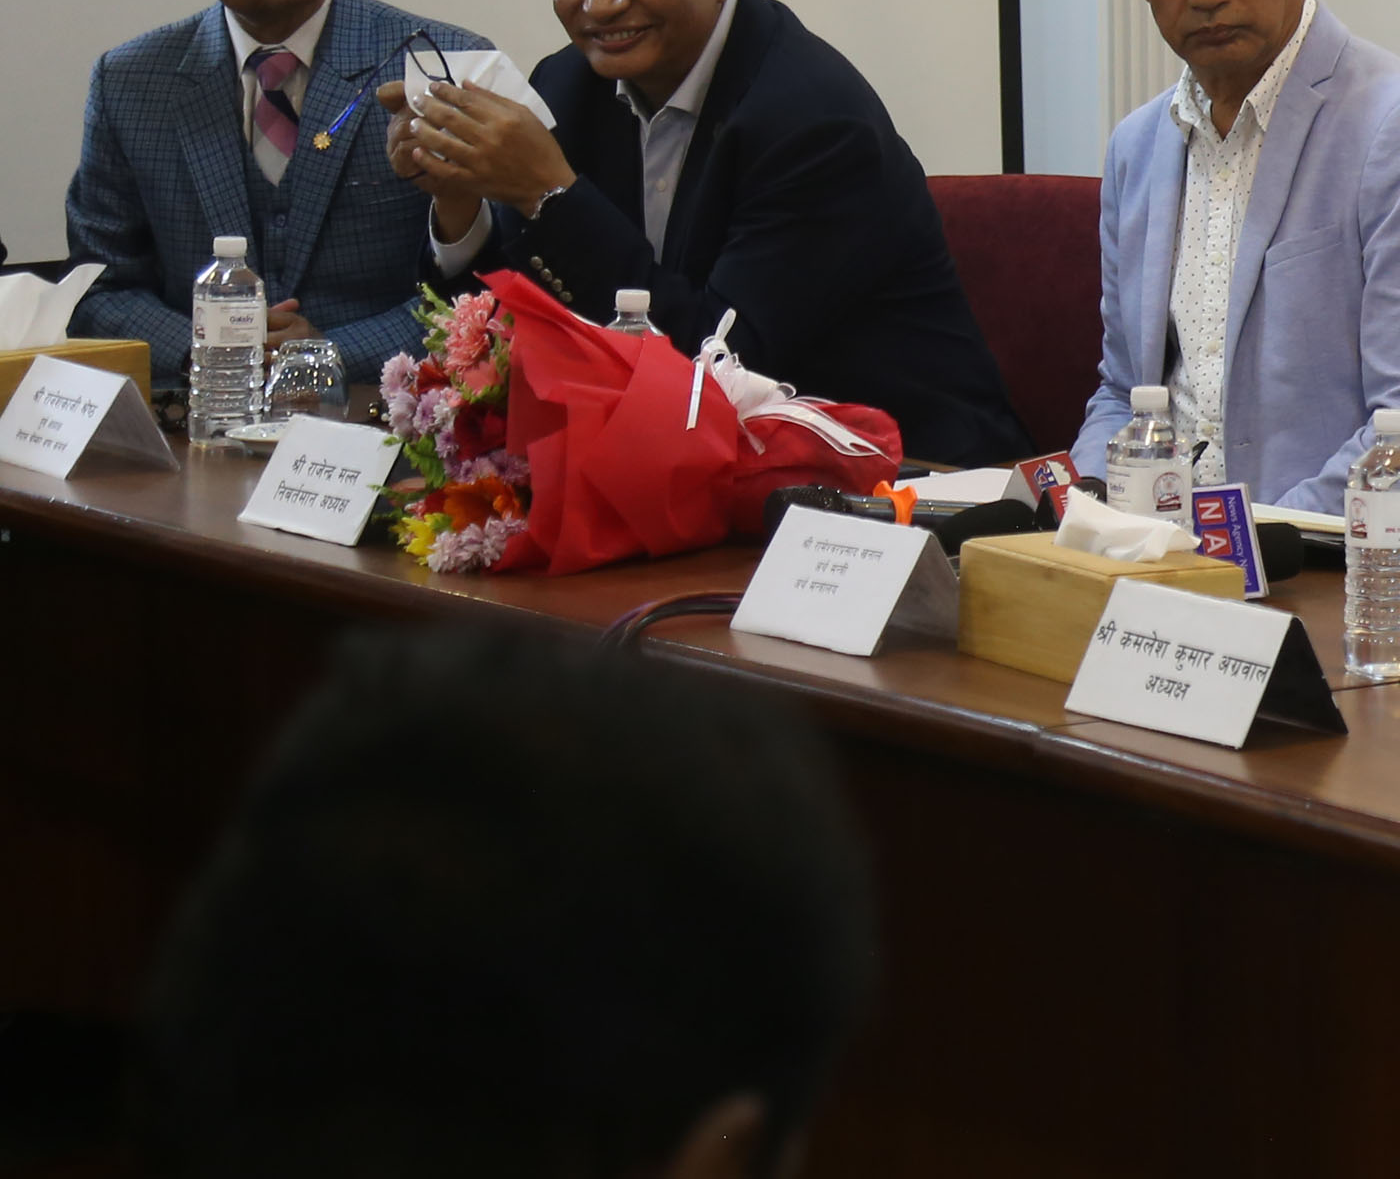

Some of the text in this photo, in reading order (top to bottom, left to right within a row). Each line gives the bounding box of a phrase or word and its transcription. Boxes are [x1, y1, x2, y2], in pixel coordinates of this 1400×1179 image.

[292, 454, 307, 475] श्री
[320, 495, 351, 514] अध्यक्ष
[1227, 495, 1238, 523] News
[1232, 524, 1244, 559] Agency
[1096, 620, 1272, 684] श्री कमलेश कुमार अग्रवाल
[1145, 674, 1192, 701] अध्यक्ष
